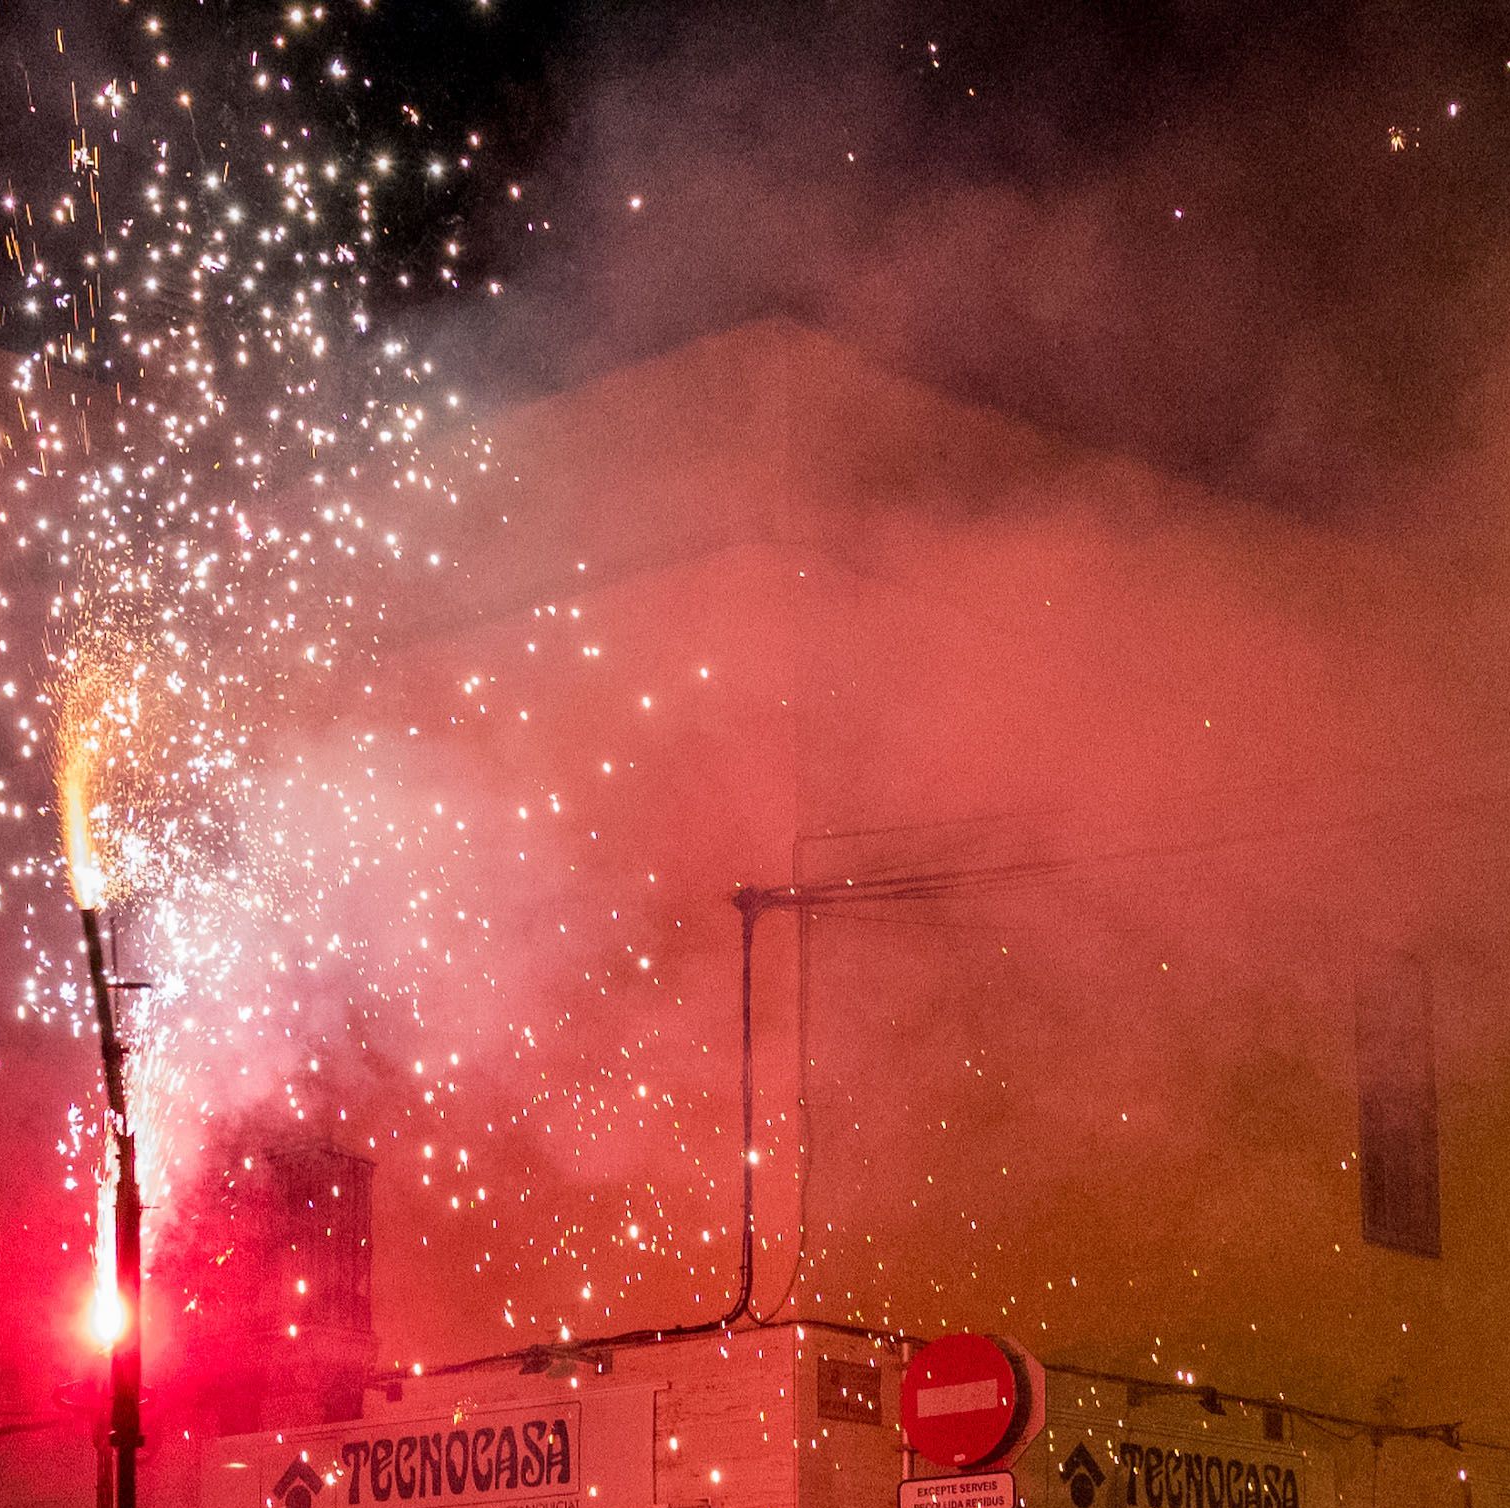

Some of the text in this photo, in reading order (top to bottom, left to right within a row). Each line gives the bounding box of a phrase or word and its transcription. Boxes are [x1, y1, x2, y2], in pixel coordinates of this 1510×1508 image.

[341, 1419, 571, 1505] TECNOCASA
[917, 1480, 998, 1497] EXCEPTE SERVEIS
